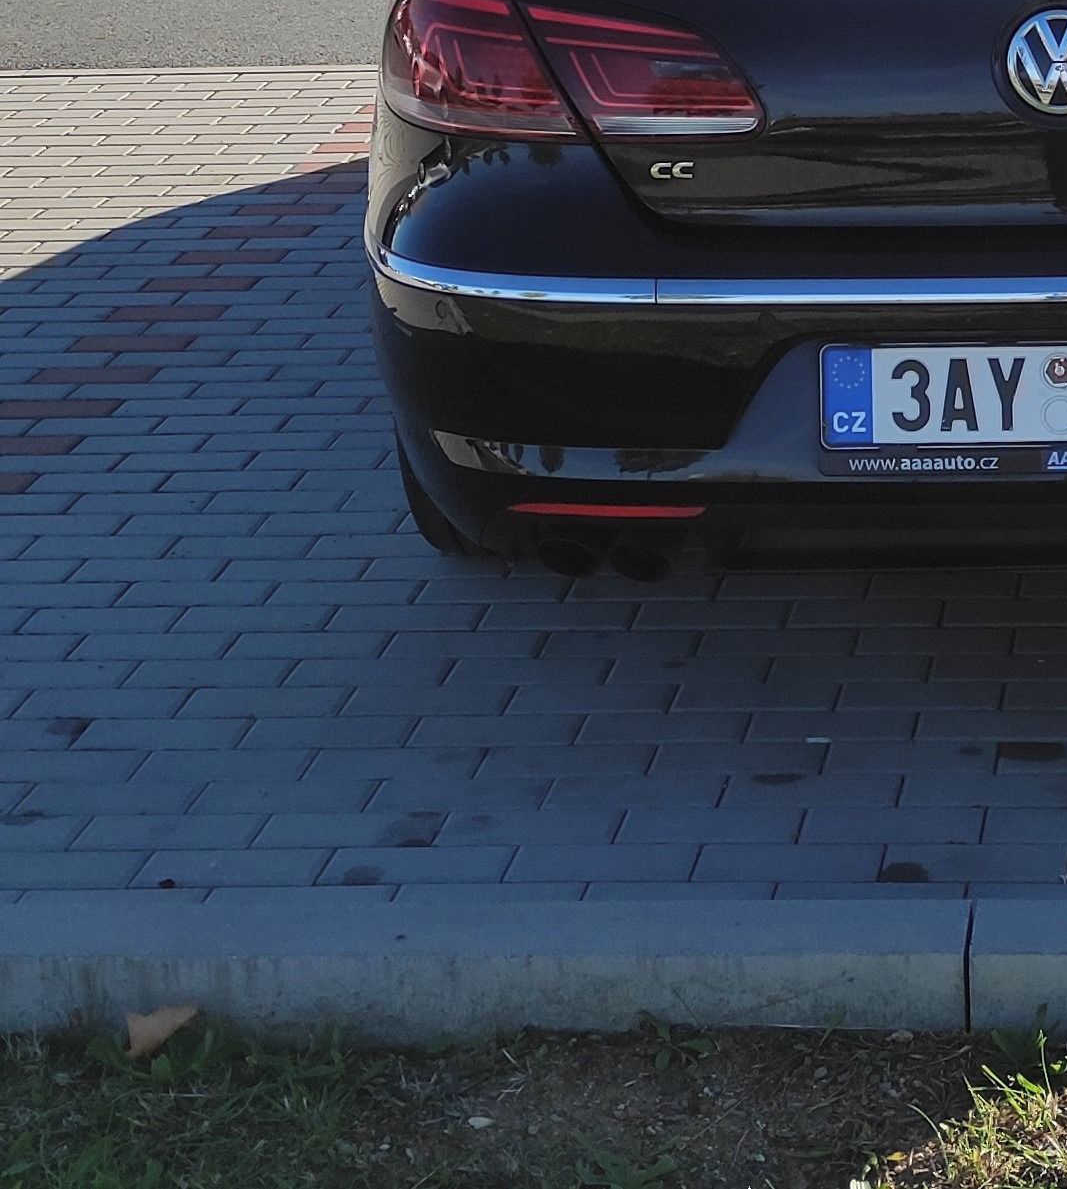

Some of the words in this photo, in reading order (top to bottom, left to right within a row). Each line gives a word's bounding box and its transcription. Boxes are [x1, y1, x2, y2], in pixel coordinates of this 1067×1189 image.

[650, 162, 694, 179] CC
[891, 358, 1026, 432] 3AY
[832, 412, 867, 433] CZ
[848, 455, 1000, 471] www.aaaauto.cz
